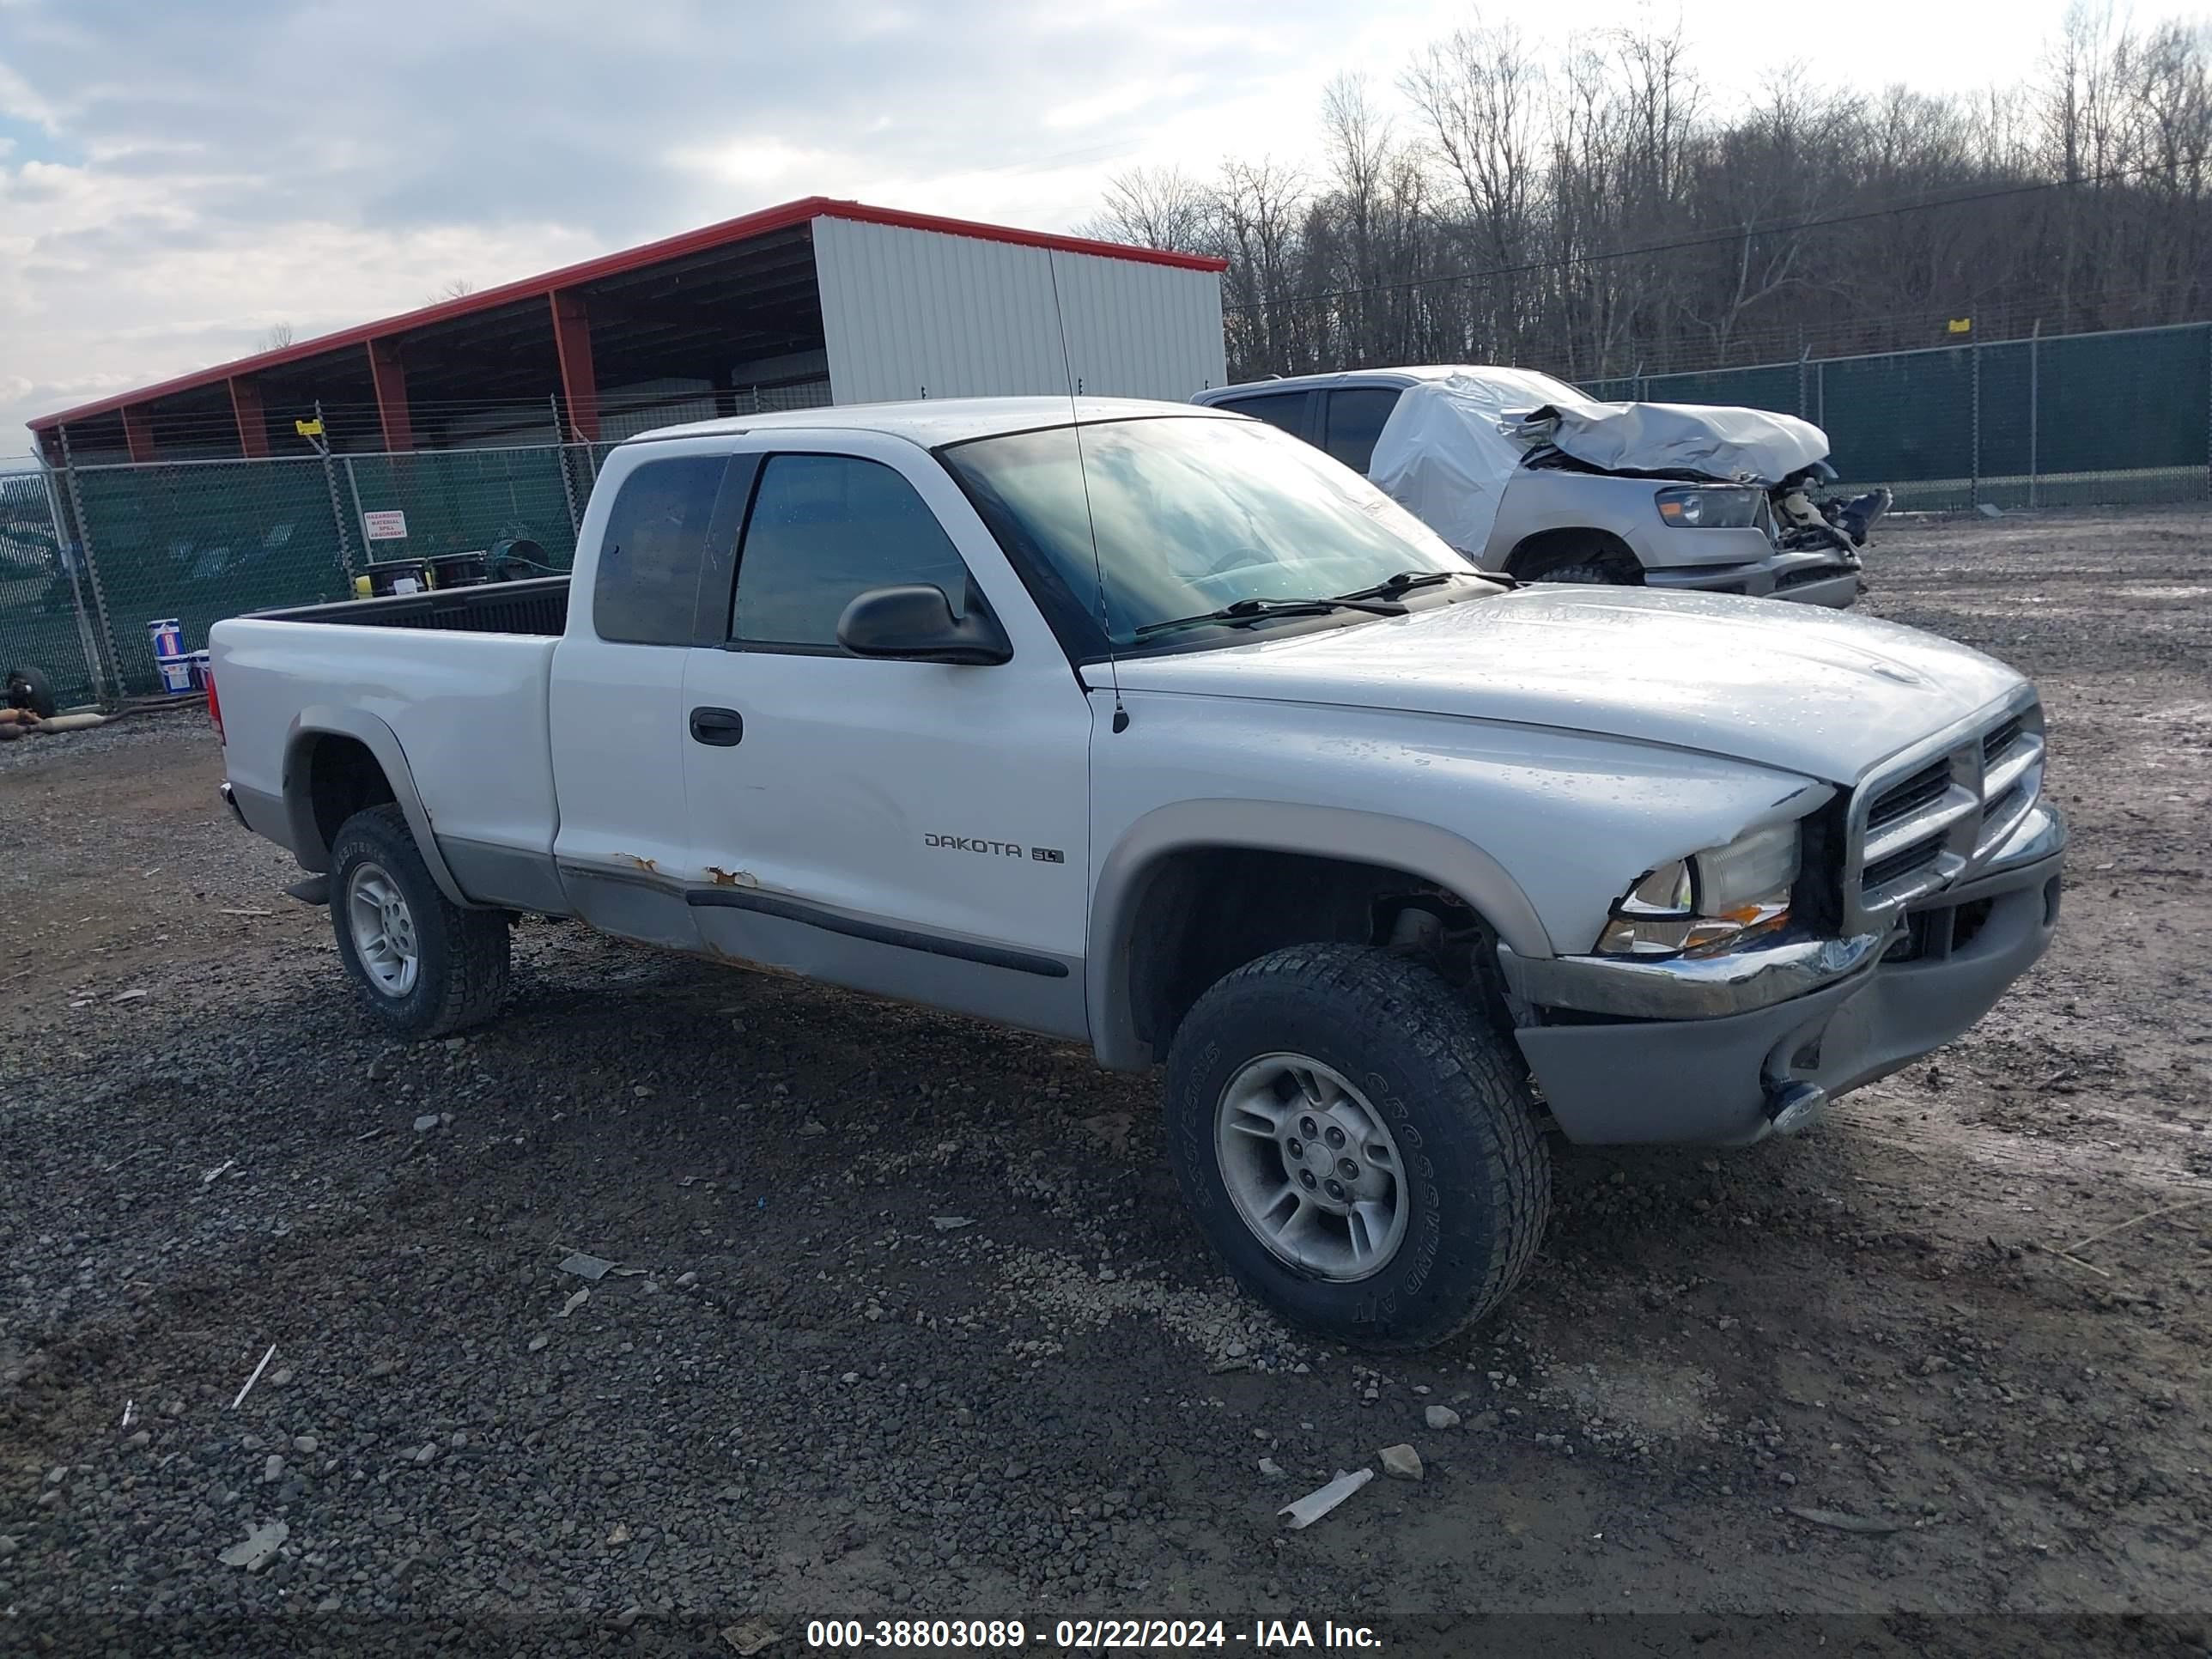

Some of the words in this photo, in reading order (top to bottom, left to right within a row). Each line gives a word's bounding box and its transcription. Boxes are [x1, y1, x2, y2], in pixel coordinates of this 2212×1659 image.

[924, 832, 1023, 859] DAKOTA
[1032, 848, 1063, 863] SLT
[1366, 1072, 1440, 1295] CROSSWIND
